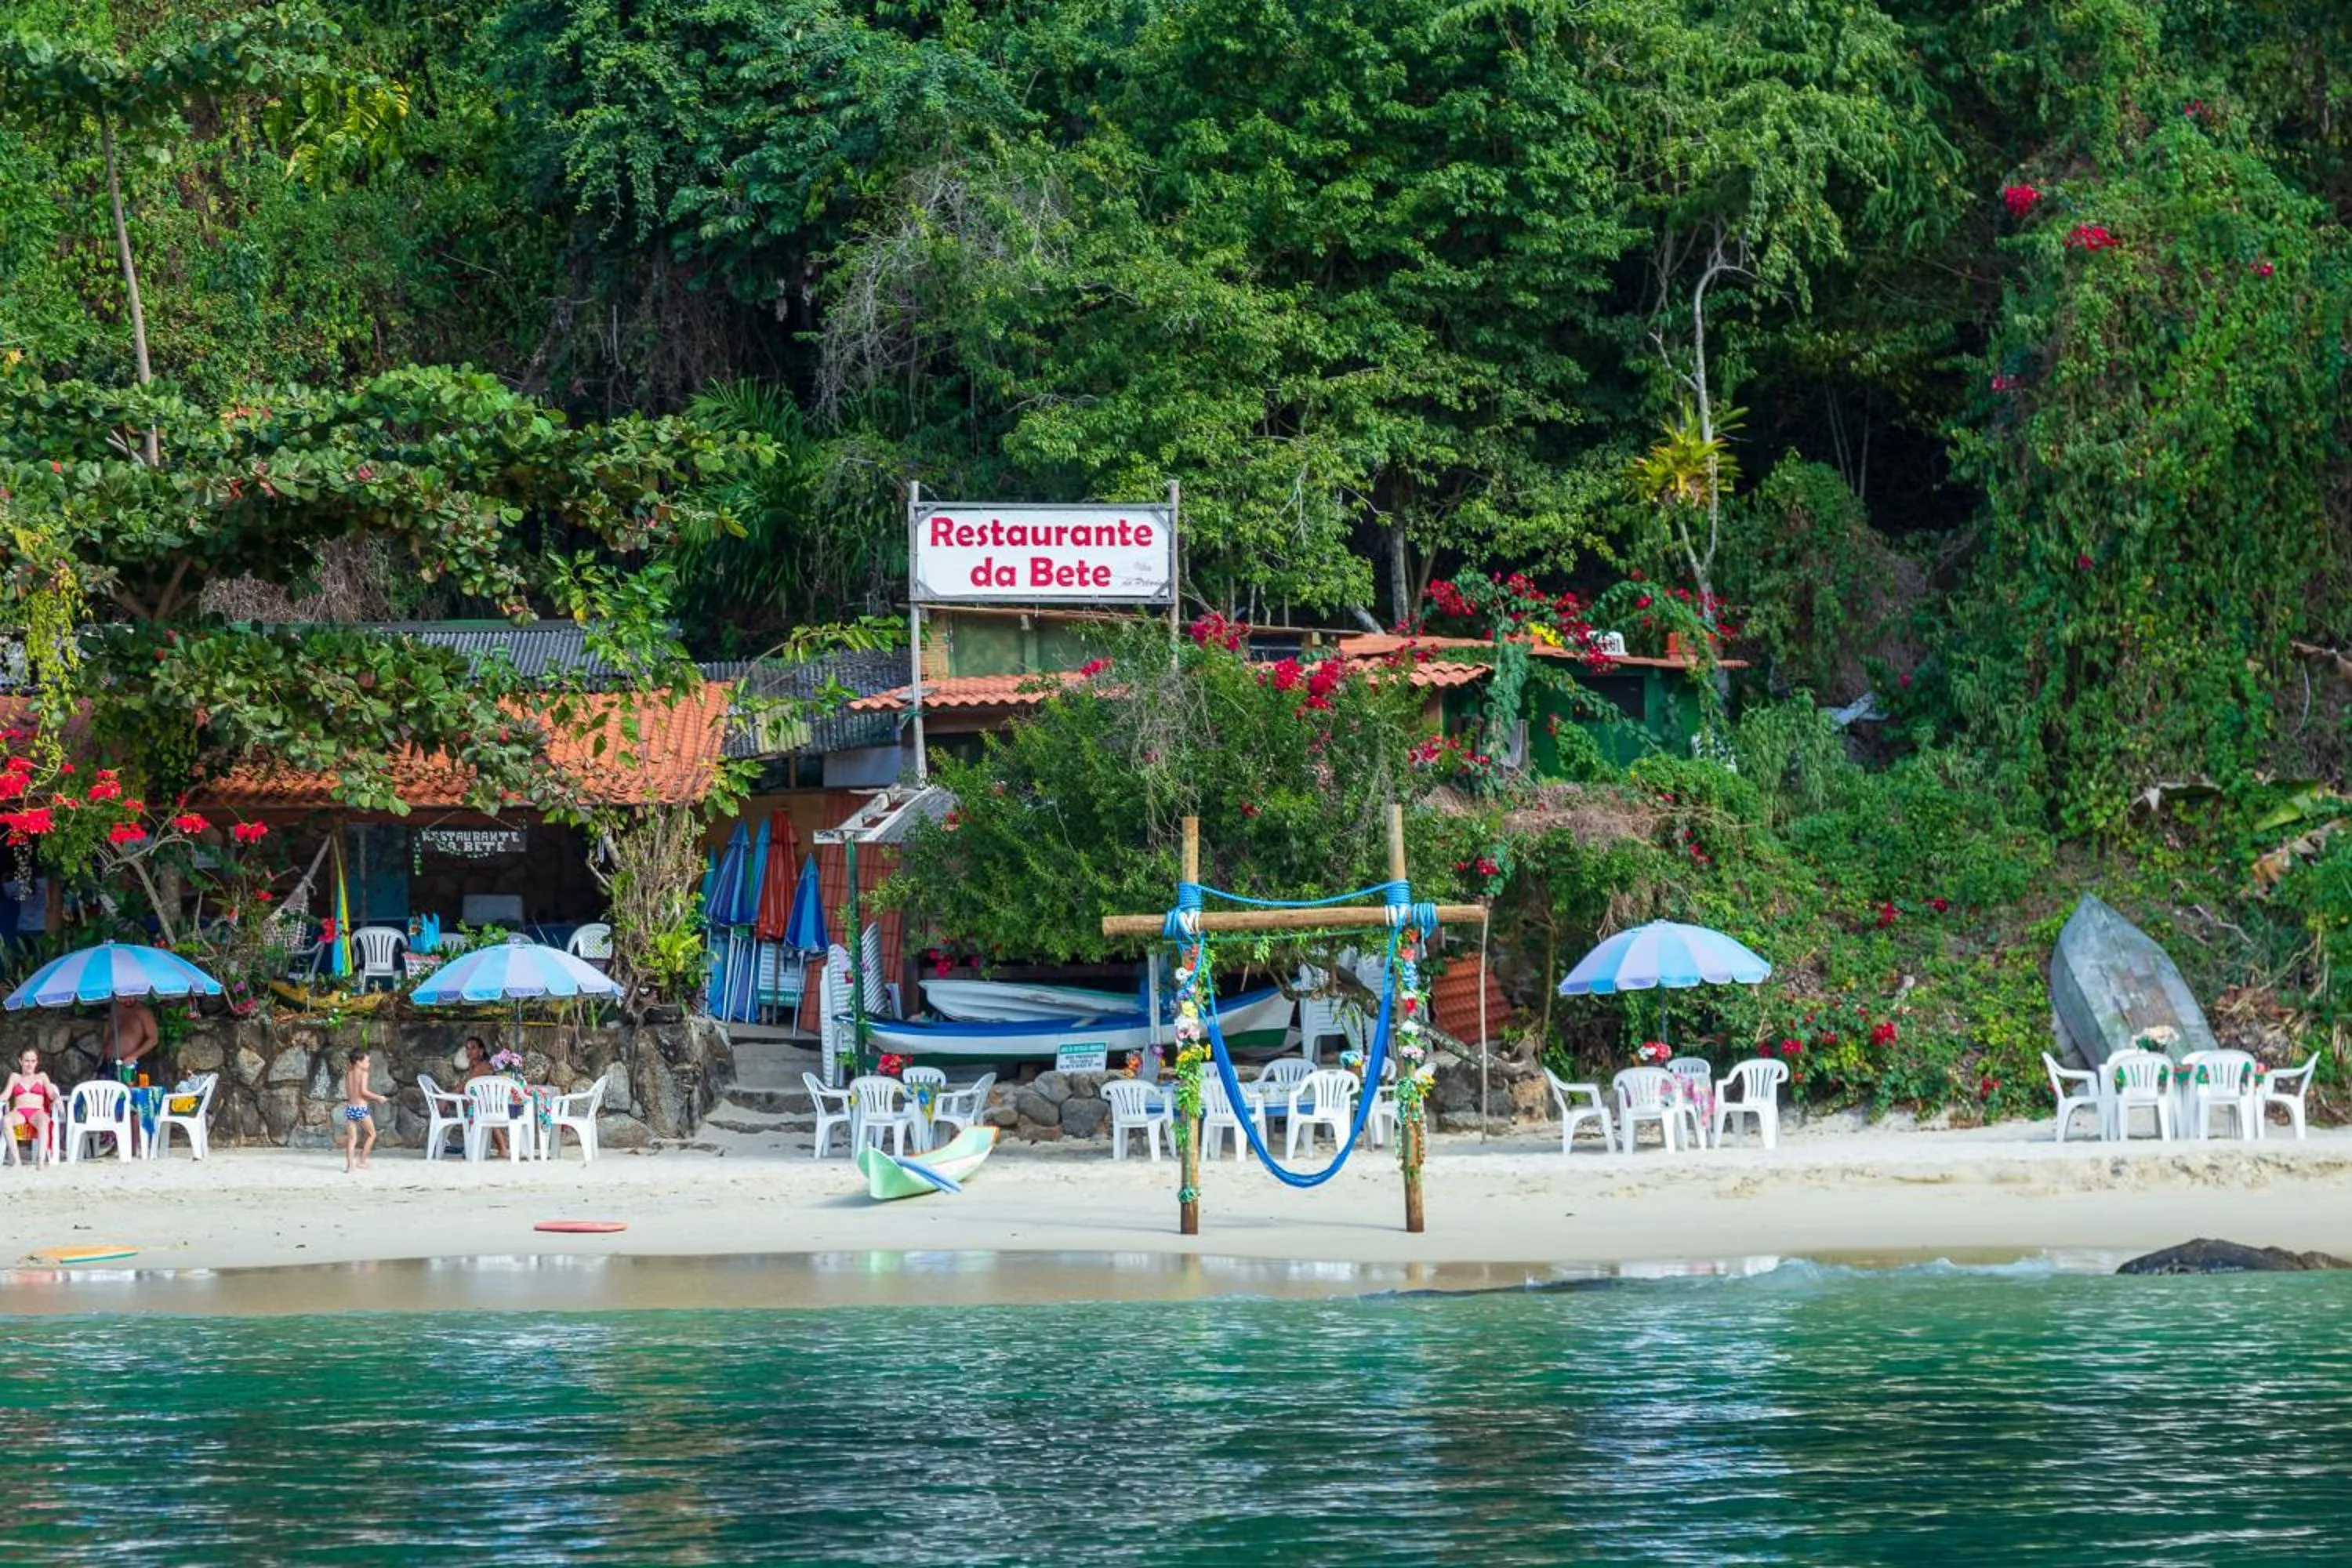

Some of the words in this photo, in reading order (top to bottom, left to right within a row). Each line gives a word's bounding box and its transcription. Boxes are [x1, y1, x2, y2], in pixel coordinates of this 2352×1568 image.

[931, 517, 1153, 547] Restaurante
[970, 557, 1017, 587] da
[1029, 557, 1111, 587] Bete
[463, 841, 506, 852] BETE
